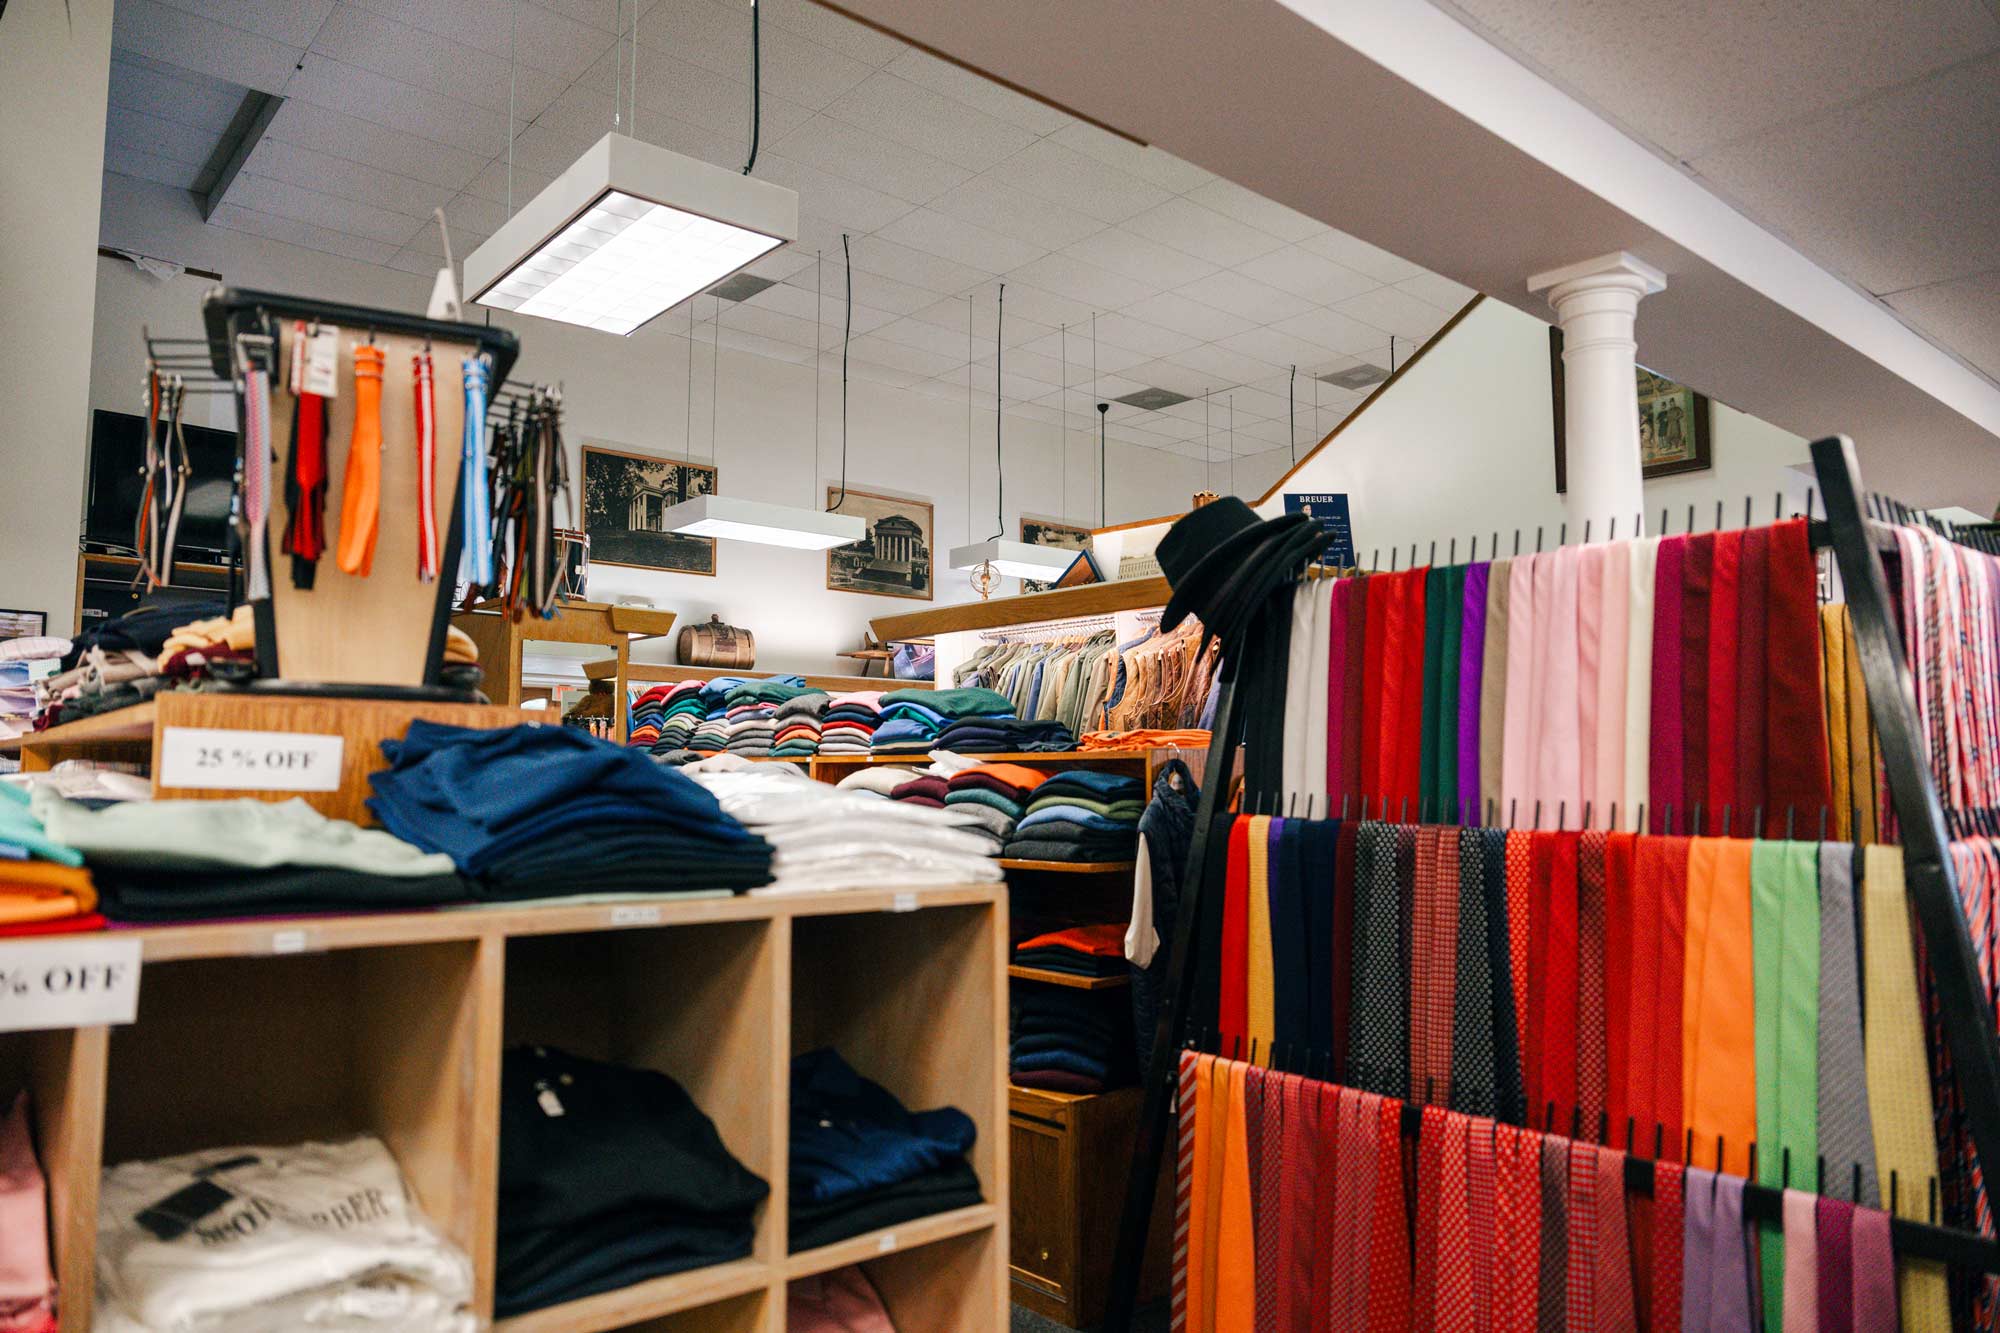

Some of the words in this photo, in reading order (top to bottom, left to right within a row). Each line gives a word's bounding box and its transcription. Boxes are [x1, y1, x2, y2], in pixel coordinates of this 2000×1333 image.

[1299, 495, 1334, 503] BREUER
[196, 747, 223, 768] 25
[231, 748, 256, 768] %
[265, 750, 317, 769] OFF
[44, 963, 125, 992] OFF
